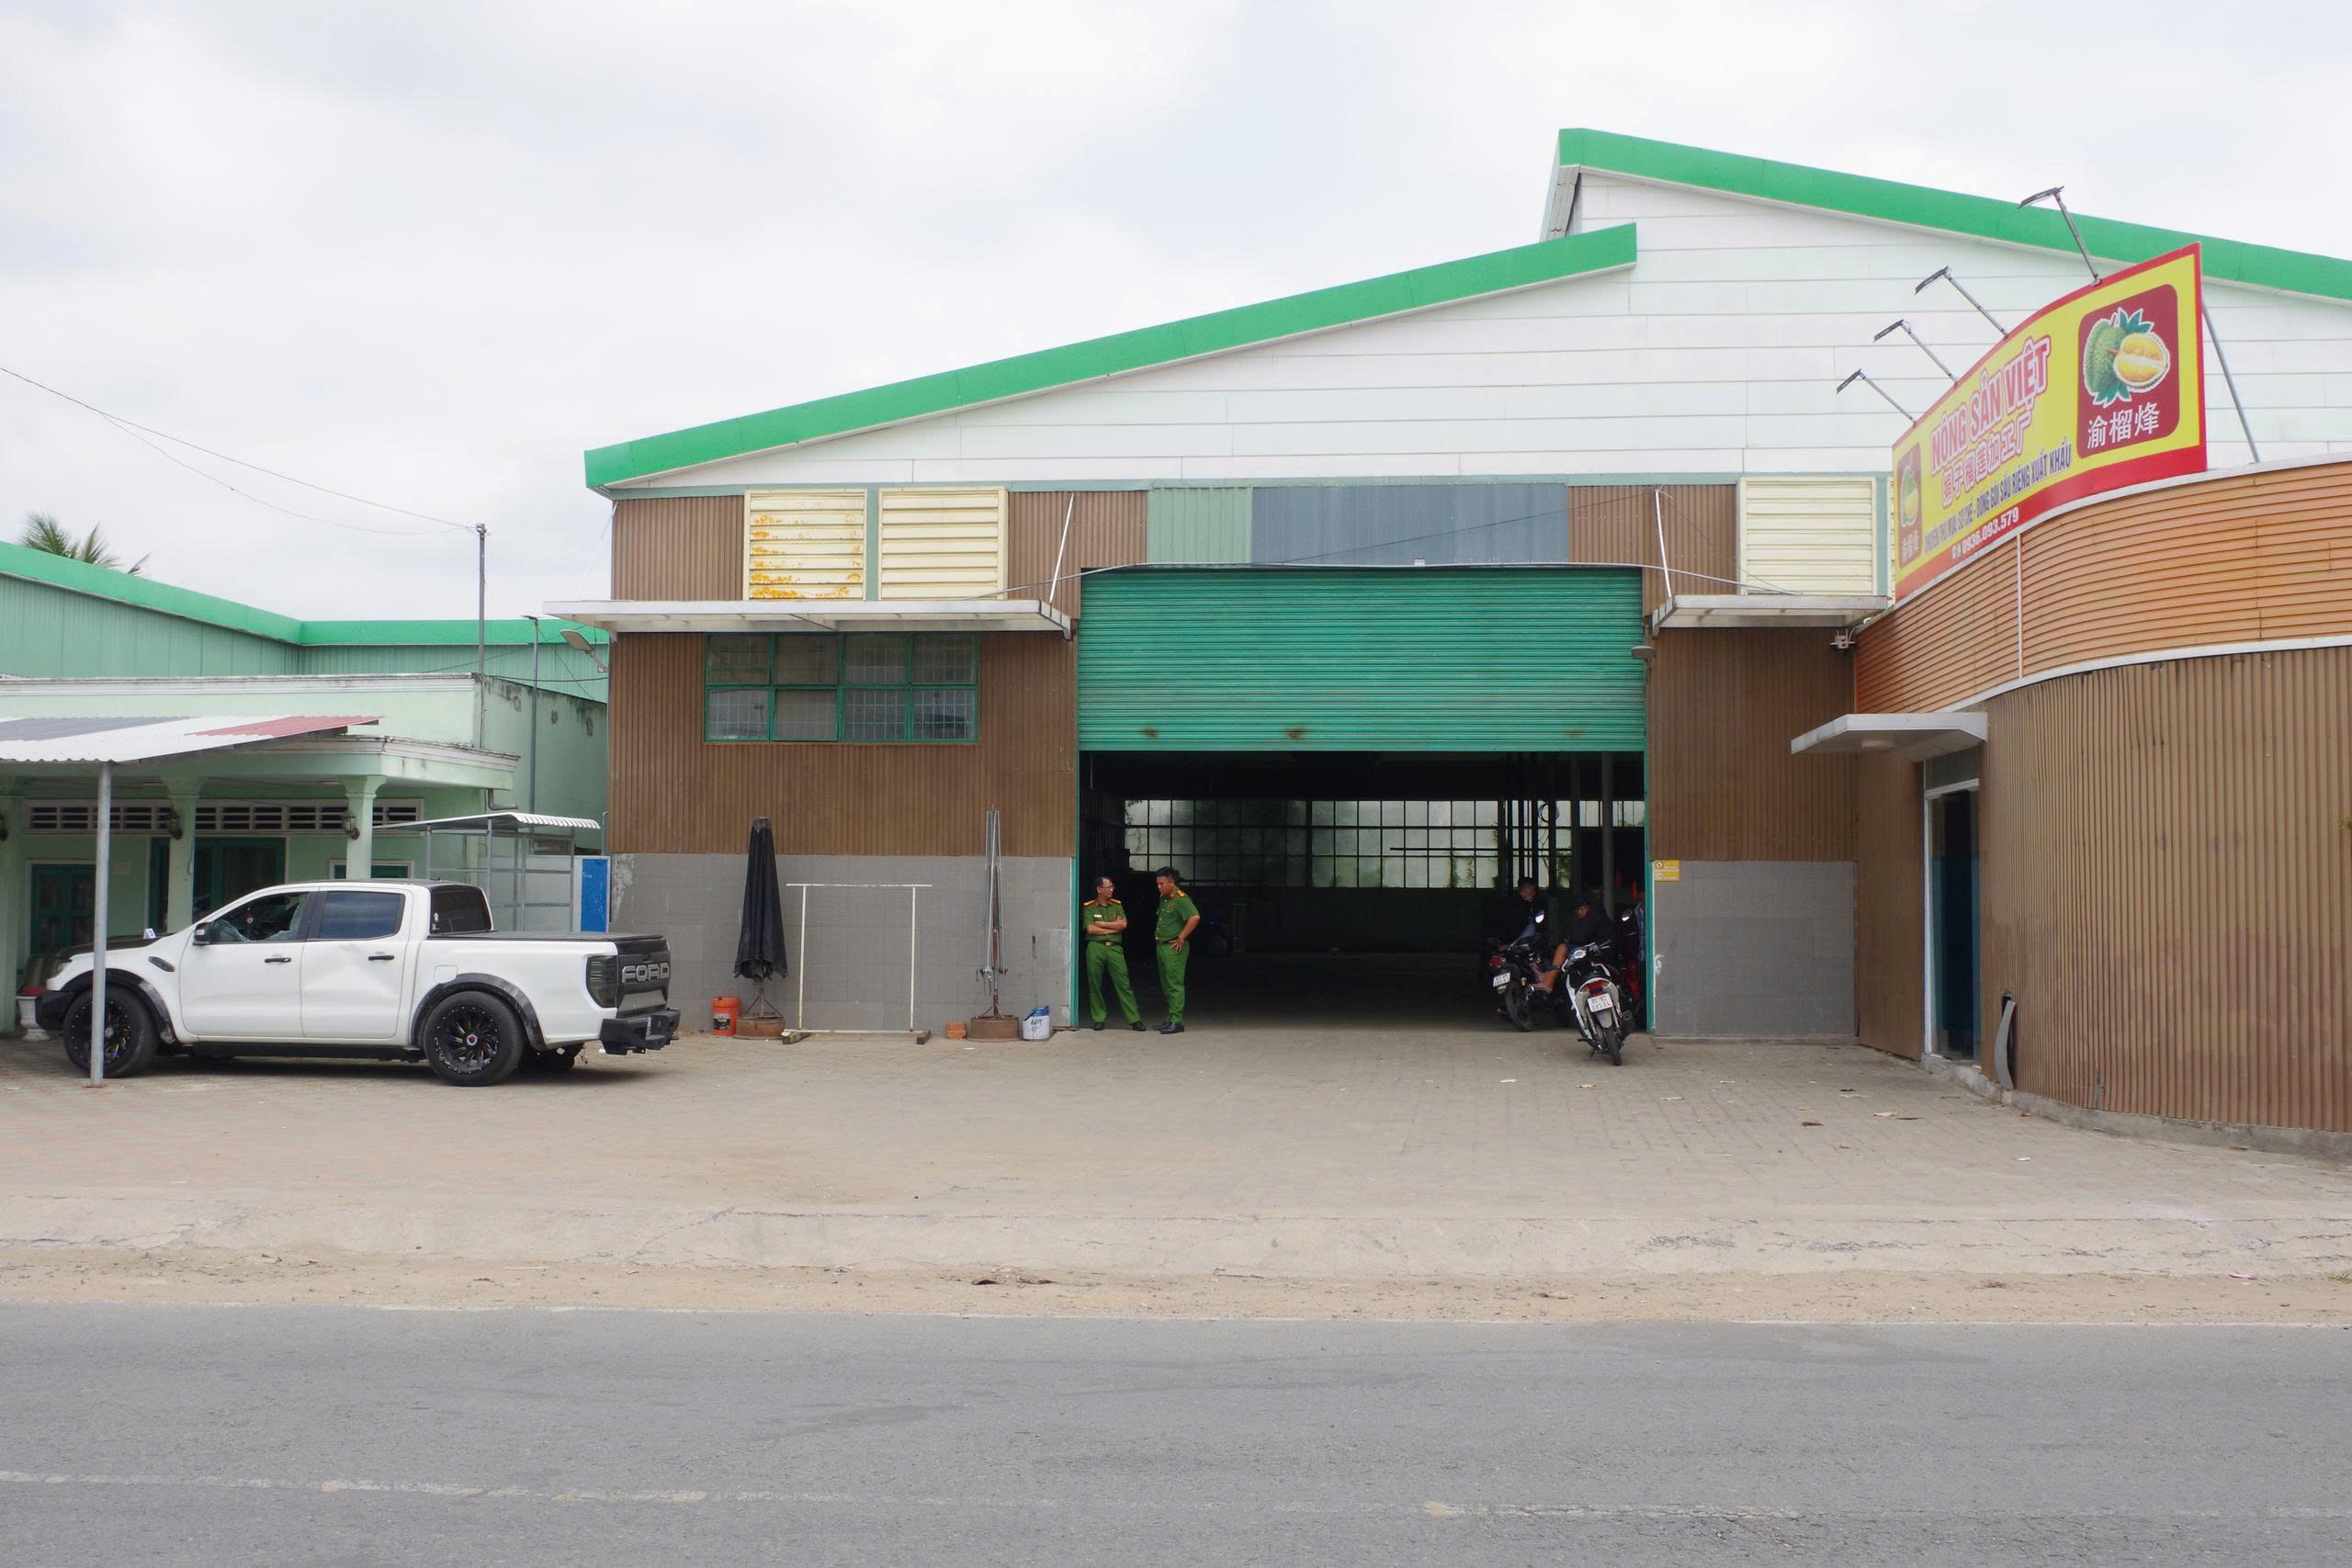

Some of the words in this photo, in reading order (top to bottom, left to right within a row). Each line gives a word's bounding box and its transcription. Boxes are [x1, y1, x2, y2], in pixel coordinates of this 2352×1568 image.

[1931, 404, 1968, 476] NÔNG
[1970, 369, 2003, 443] SẢN
[2004, 335, 2051, 413] VIỆT
[2087, 402, 2160, 448] 渝榴烽
[2049, 436, 2072, 474] KHẨU
[622, 962, 670, 983] FORD
